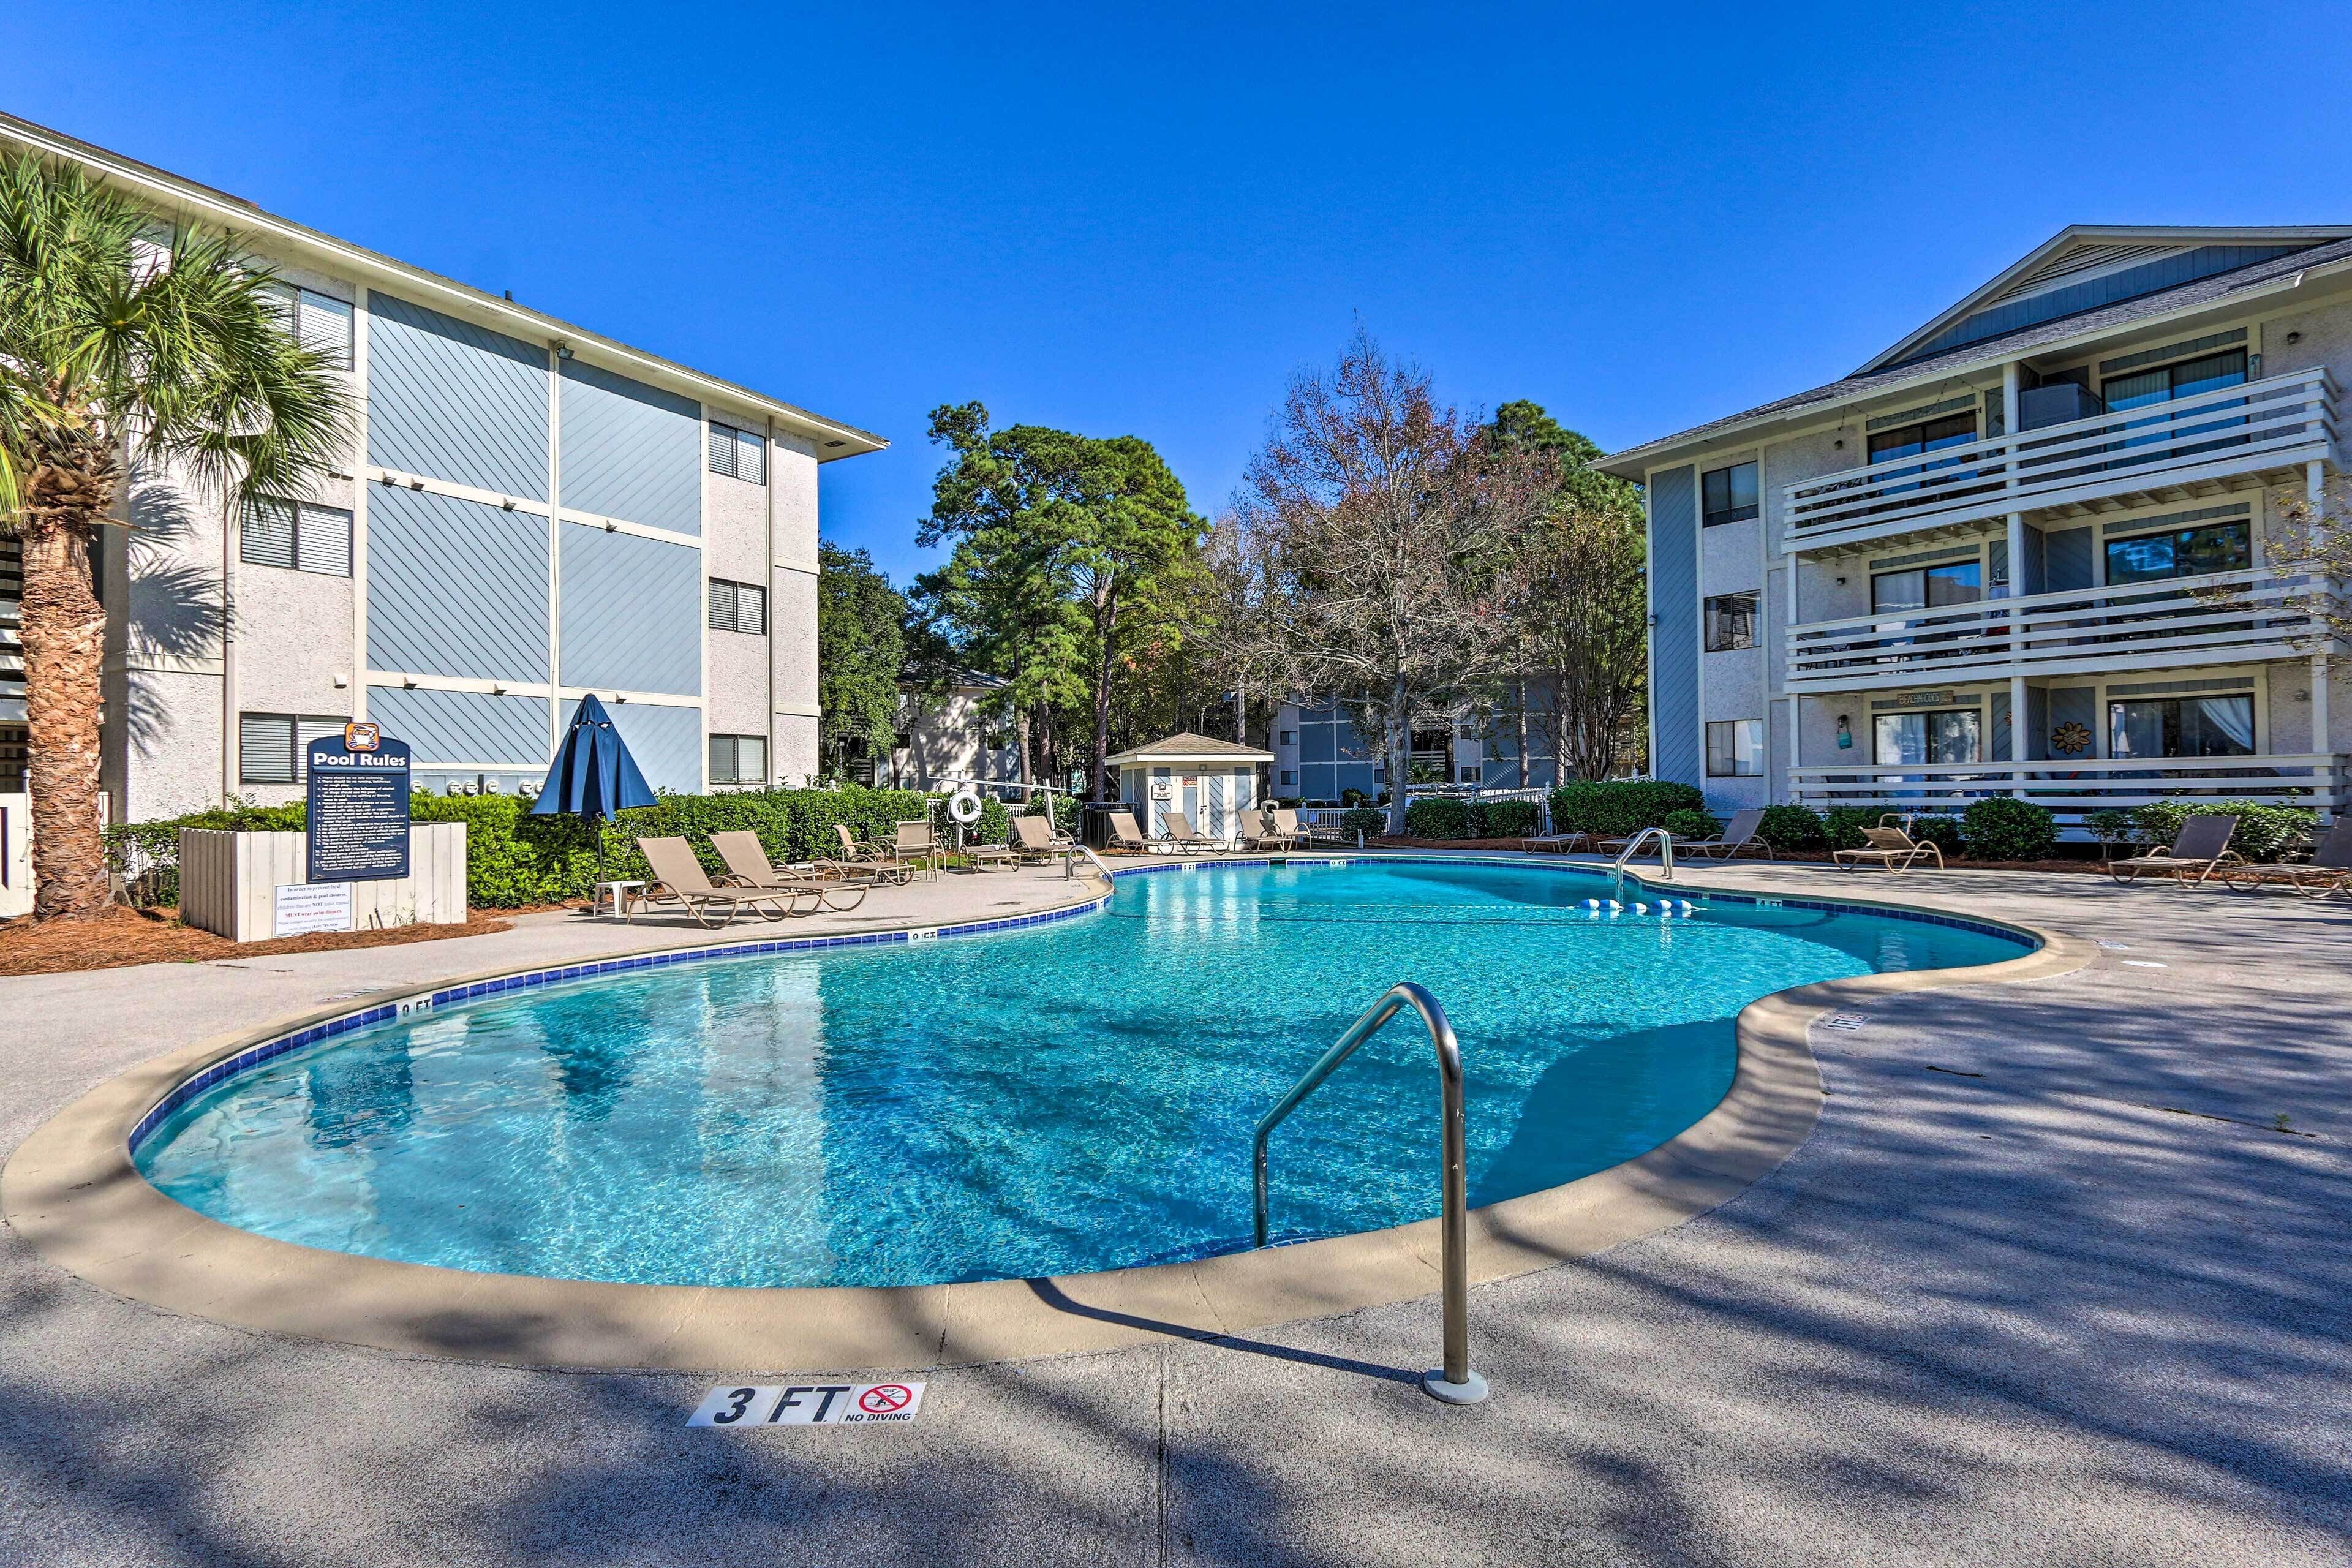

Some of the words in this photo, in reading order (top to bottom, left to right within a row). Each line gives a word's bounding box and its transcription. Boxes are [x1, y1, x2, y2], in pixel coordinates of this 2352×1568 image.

[314, 753, 355, 766] Pool
[360, 753, 405, 766] Rules
[714, 1387, 756, 1423] 3
[768, 1386, 851, 1422] FT
